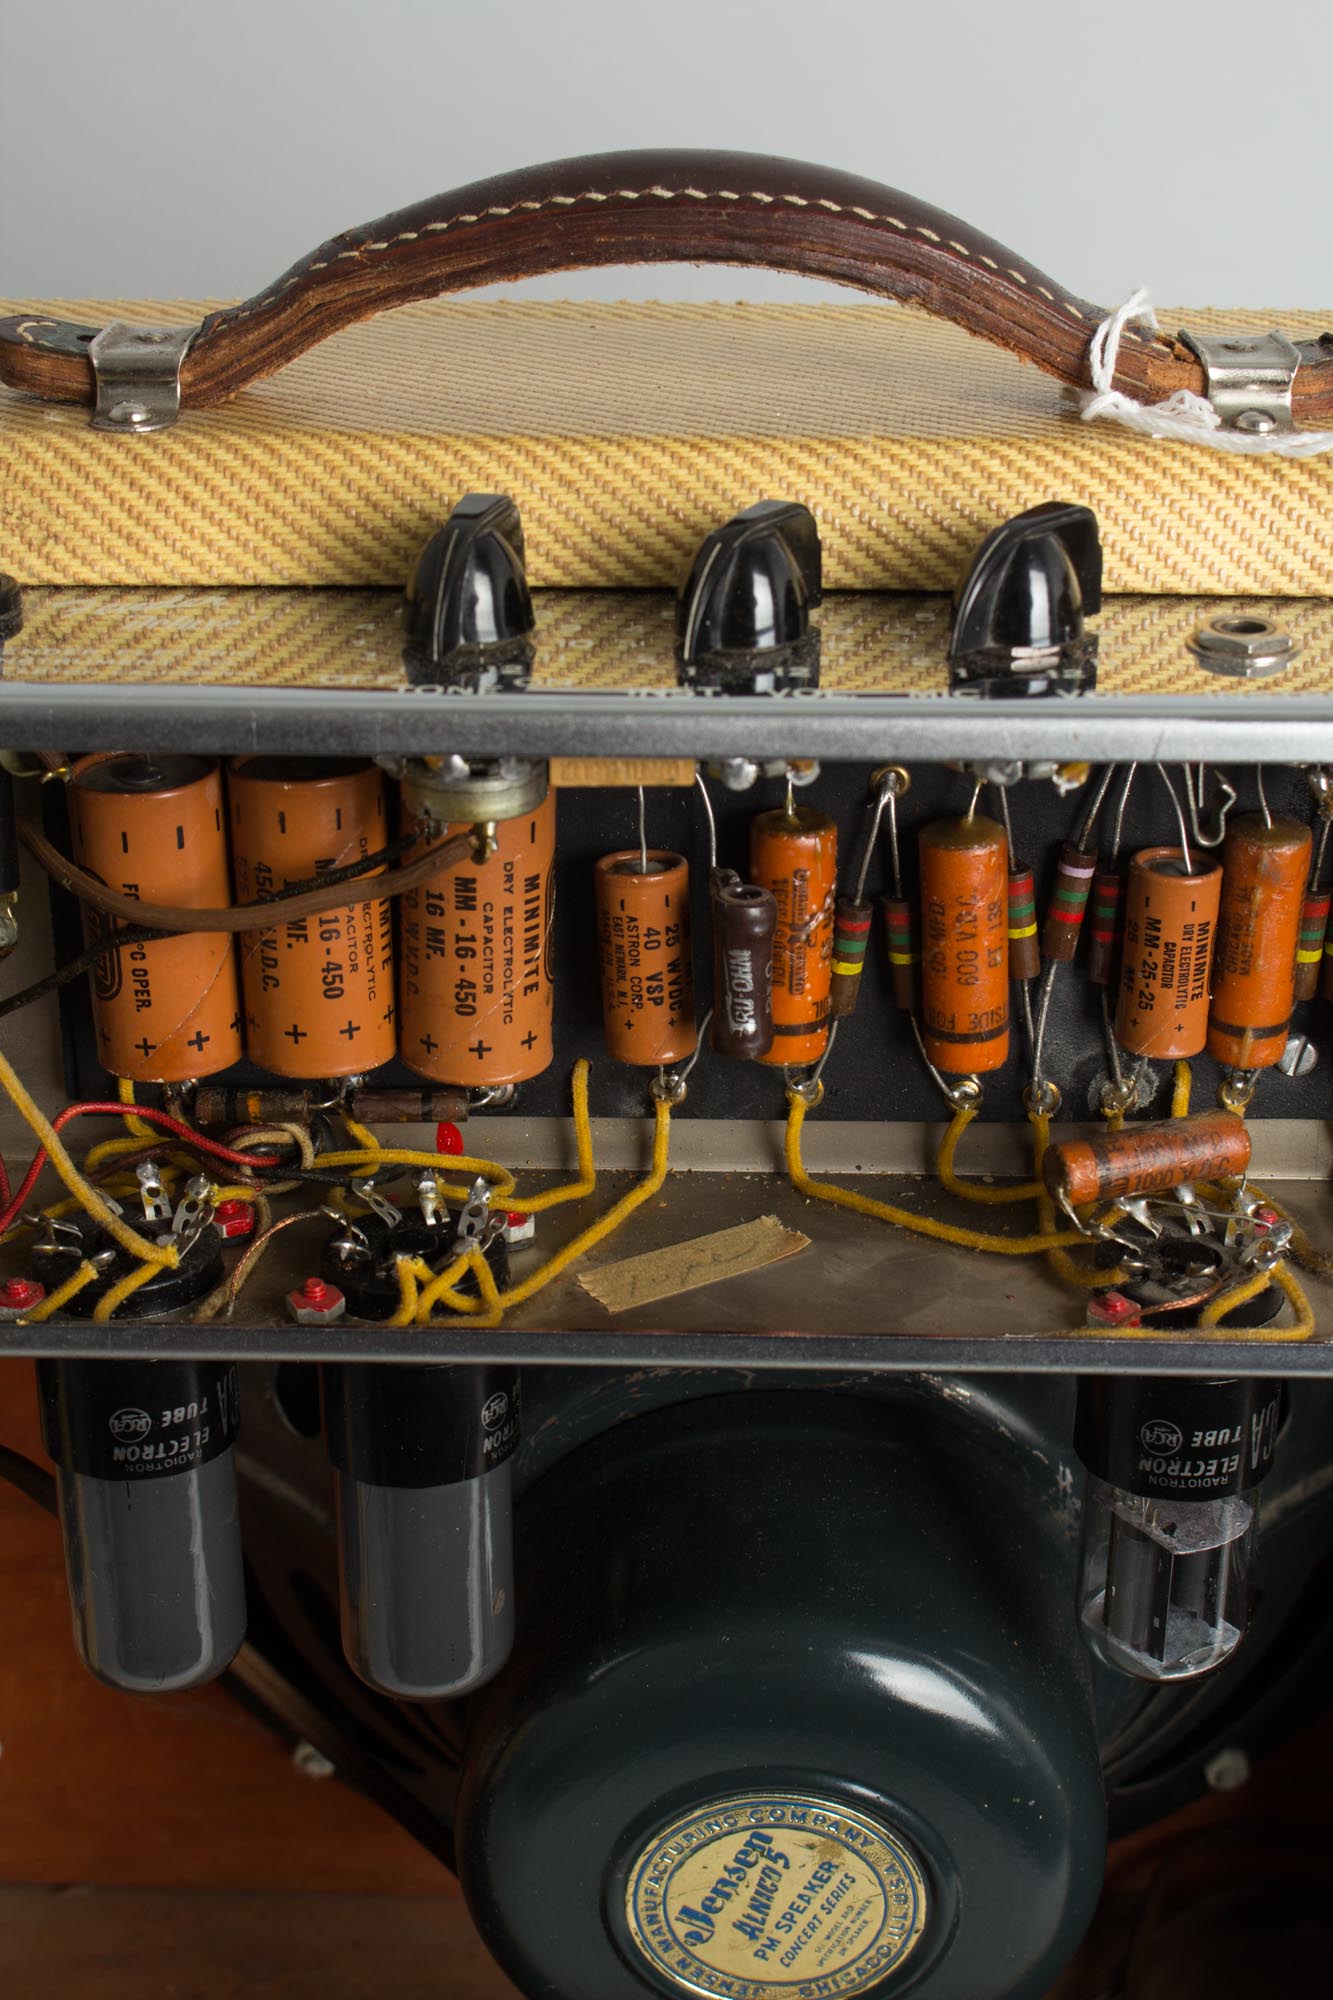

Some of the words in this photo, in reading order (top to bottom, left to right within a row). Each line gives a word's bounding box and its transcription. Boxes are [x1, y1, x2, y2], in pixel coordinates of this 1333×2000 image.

[394, 684, 505, 697] TONE
[503, 861, 514, 894] DRY
[425, 889, 446, 917] 16
[425, 926, 446, 960] MF.
[524, 873, 541, 997] MINIMITE
[612, 916, 625, 940] EAST
[626, 915, 641, 967] ASTRON
[643, 927, 661, 951] 40
[665, 923, 681, 948] 25
[1182, 924, 1195, 942] DRY
[482, 902, 494, 994] CAPACITOR
[503, 906, 514, 1025] ELECTROLYTIC
[1160, 942, 1177, 990] CAPACITOR
[1190, 921, 1211, 1001] MINIMITE
[667, 956, 682, 1012] WVDC
[956, 949, 979, 986] 600
[1175, 946, 1192, 1010] ELECTROLYTIC
[132, 968, 152, 1012] OPER.
[631, 976, 644, 1013] CORP.
[646, 971, 664, 1007] VSP
[160, 1396, 208, 1429] TUBE
[112, 1425, 211, 1461] ELECTRON
[1191, 1425, 1241, 1448] TUBE
[121, 1450, 203, 1472] RADIOTRON
[1139, 1454, 1240, 1478] ELECTRON
[1148, 1474, 1229, 1488] RADIOTRON
[748, 1808, 875, 1849] COMPANY
[643, 1813, 738, 1953] MANUFACTURING
[675, 1831, 773, 1947] Jensen
[732, 1864, 783, 1941] ALNICO
[764, 1846, 790, 1870] 5
[753, 1936, 781, 1962] PM
[775, 1860, 840, 1934] SPEAKER
[780, 1913, 823, 1968] CONCERT
[820, 1871, 856, 1915] SERIES
[675, 1957, 767, 1998] JENSEN
